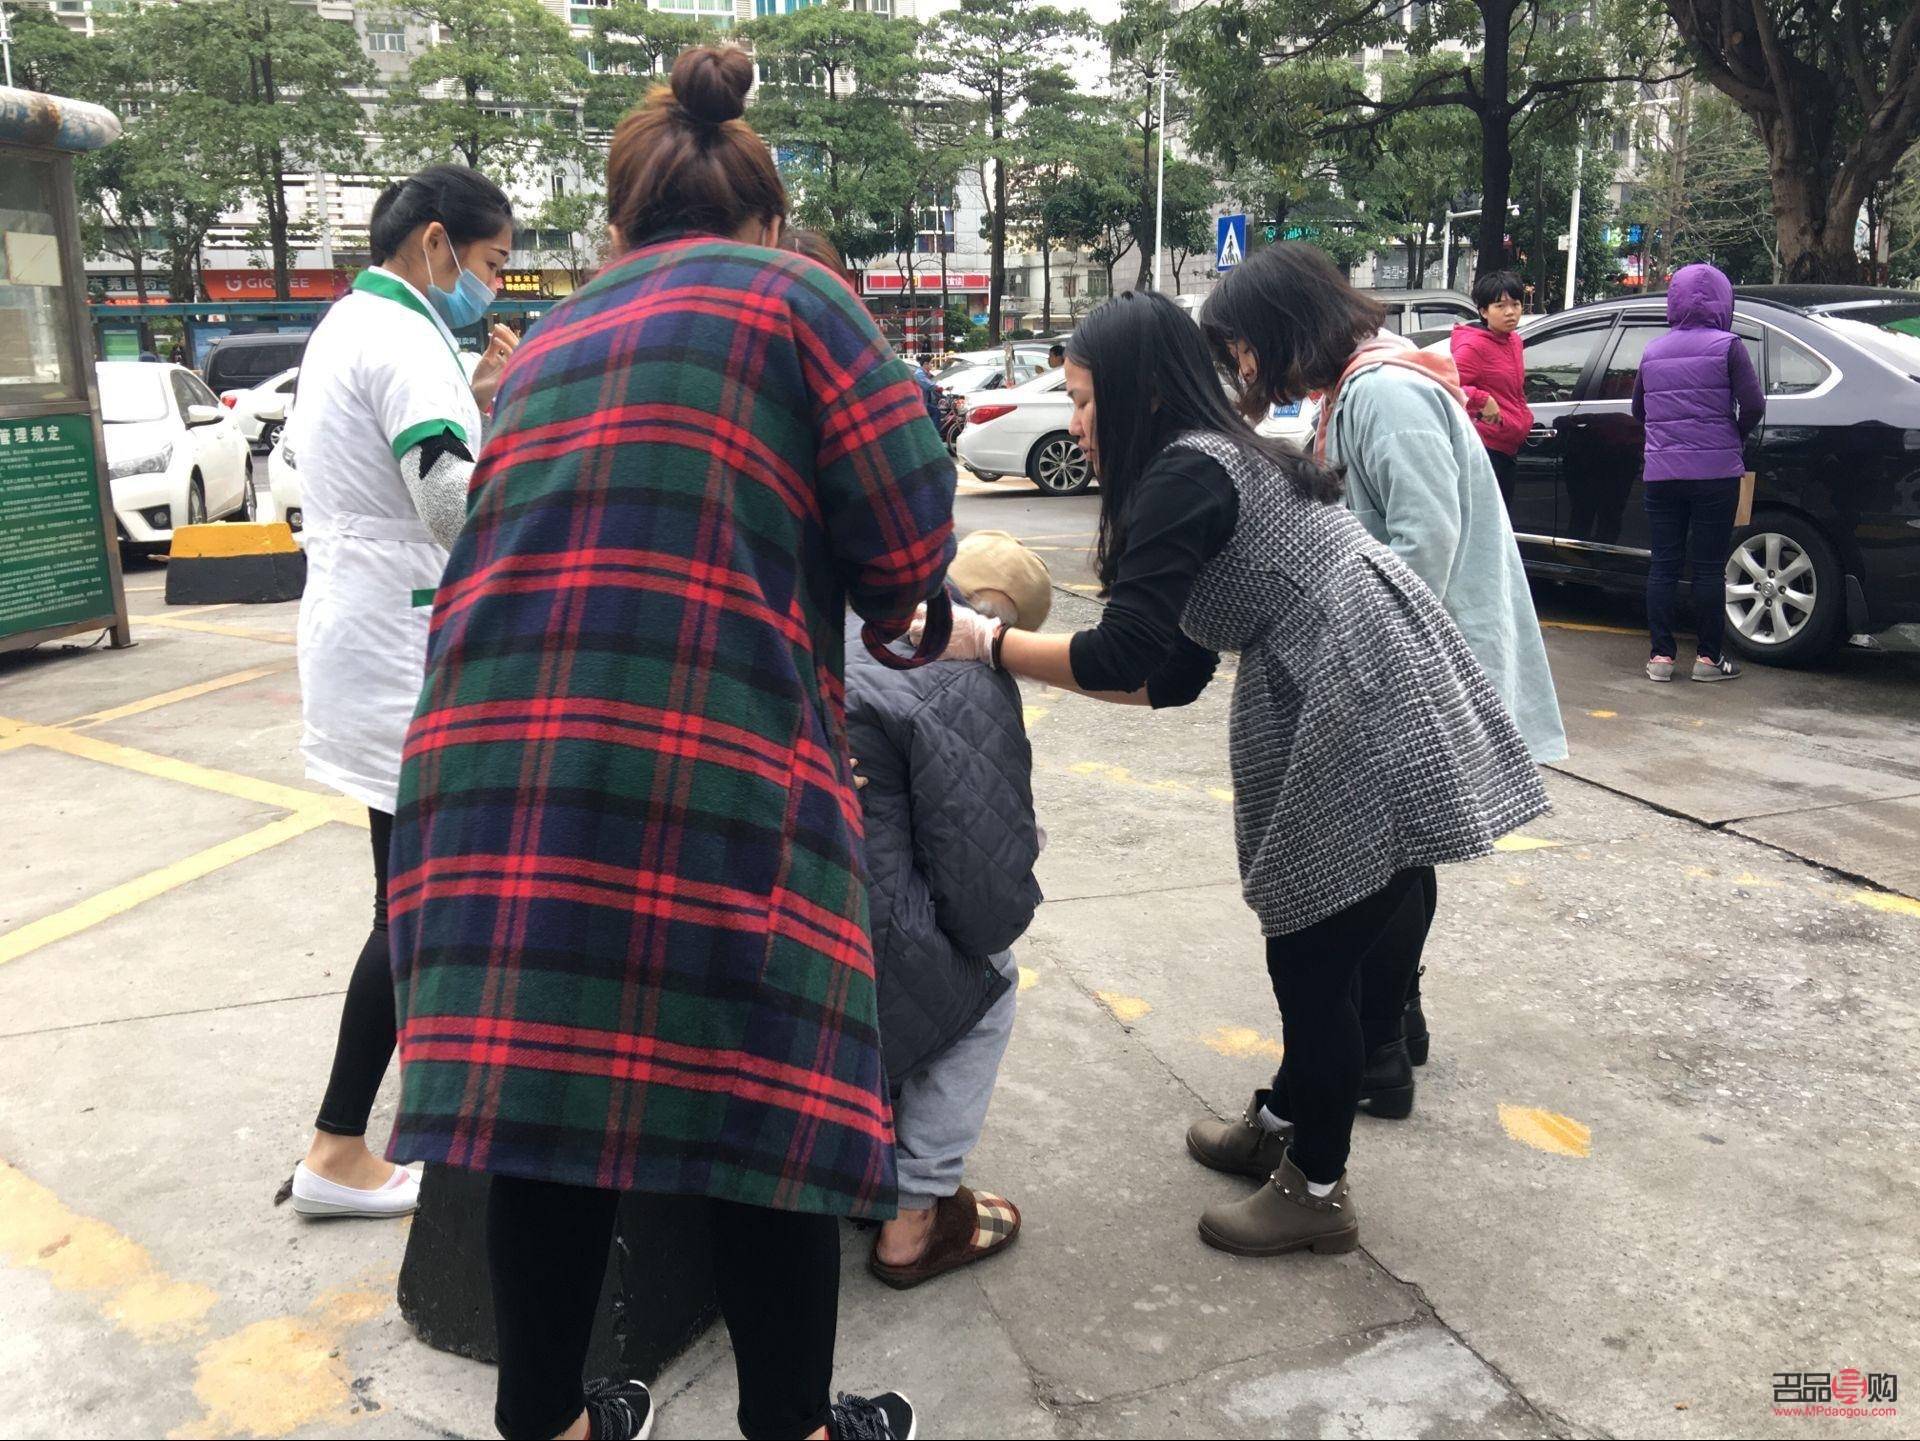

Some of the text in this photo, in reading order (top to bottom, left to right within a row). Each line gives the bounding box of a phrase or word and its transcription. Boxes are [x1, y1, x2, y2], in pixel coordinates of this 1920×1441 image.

[246, 278, 310, 288] GIOEE
[0, 424, 61, 446] 管理规定
[1723, 662, 1732, 673] N
